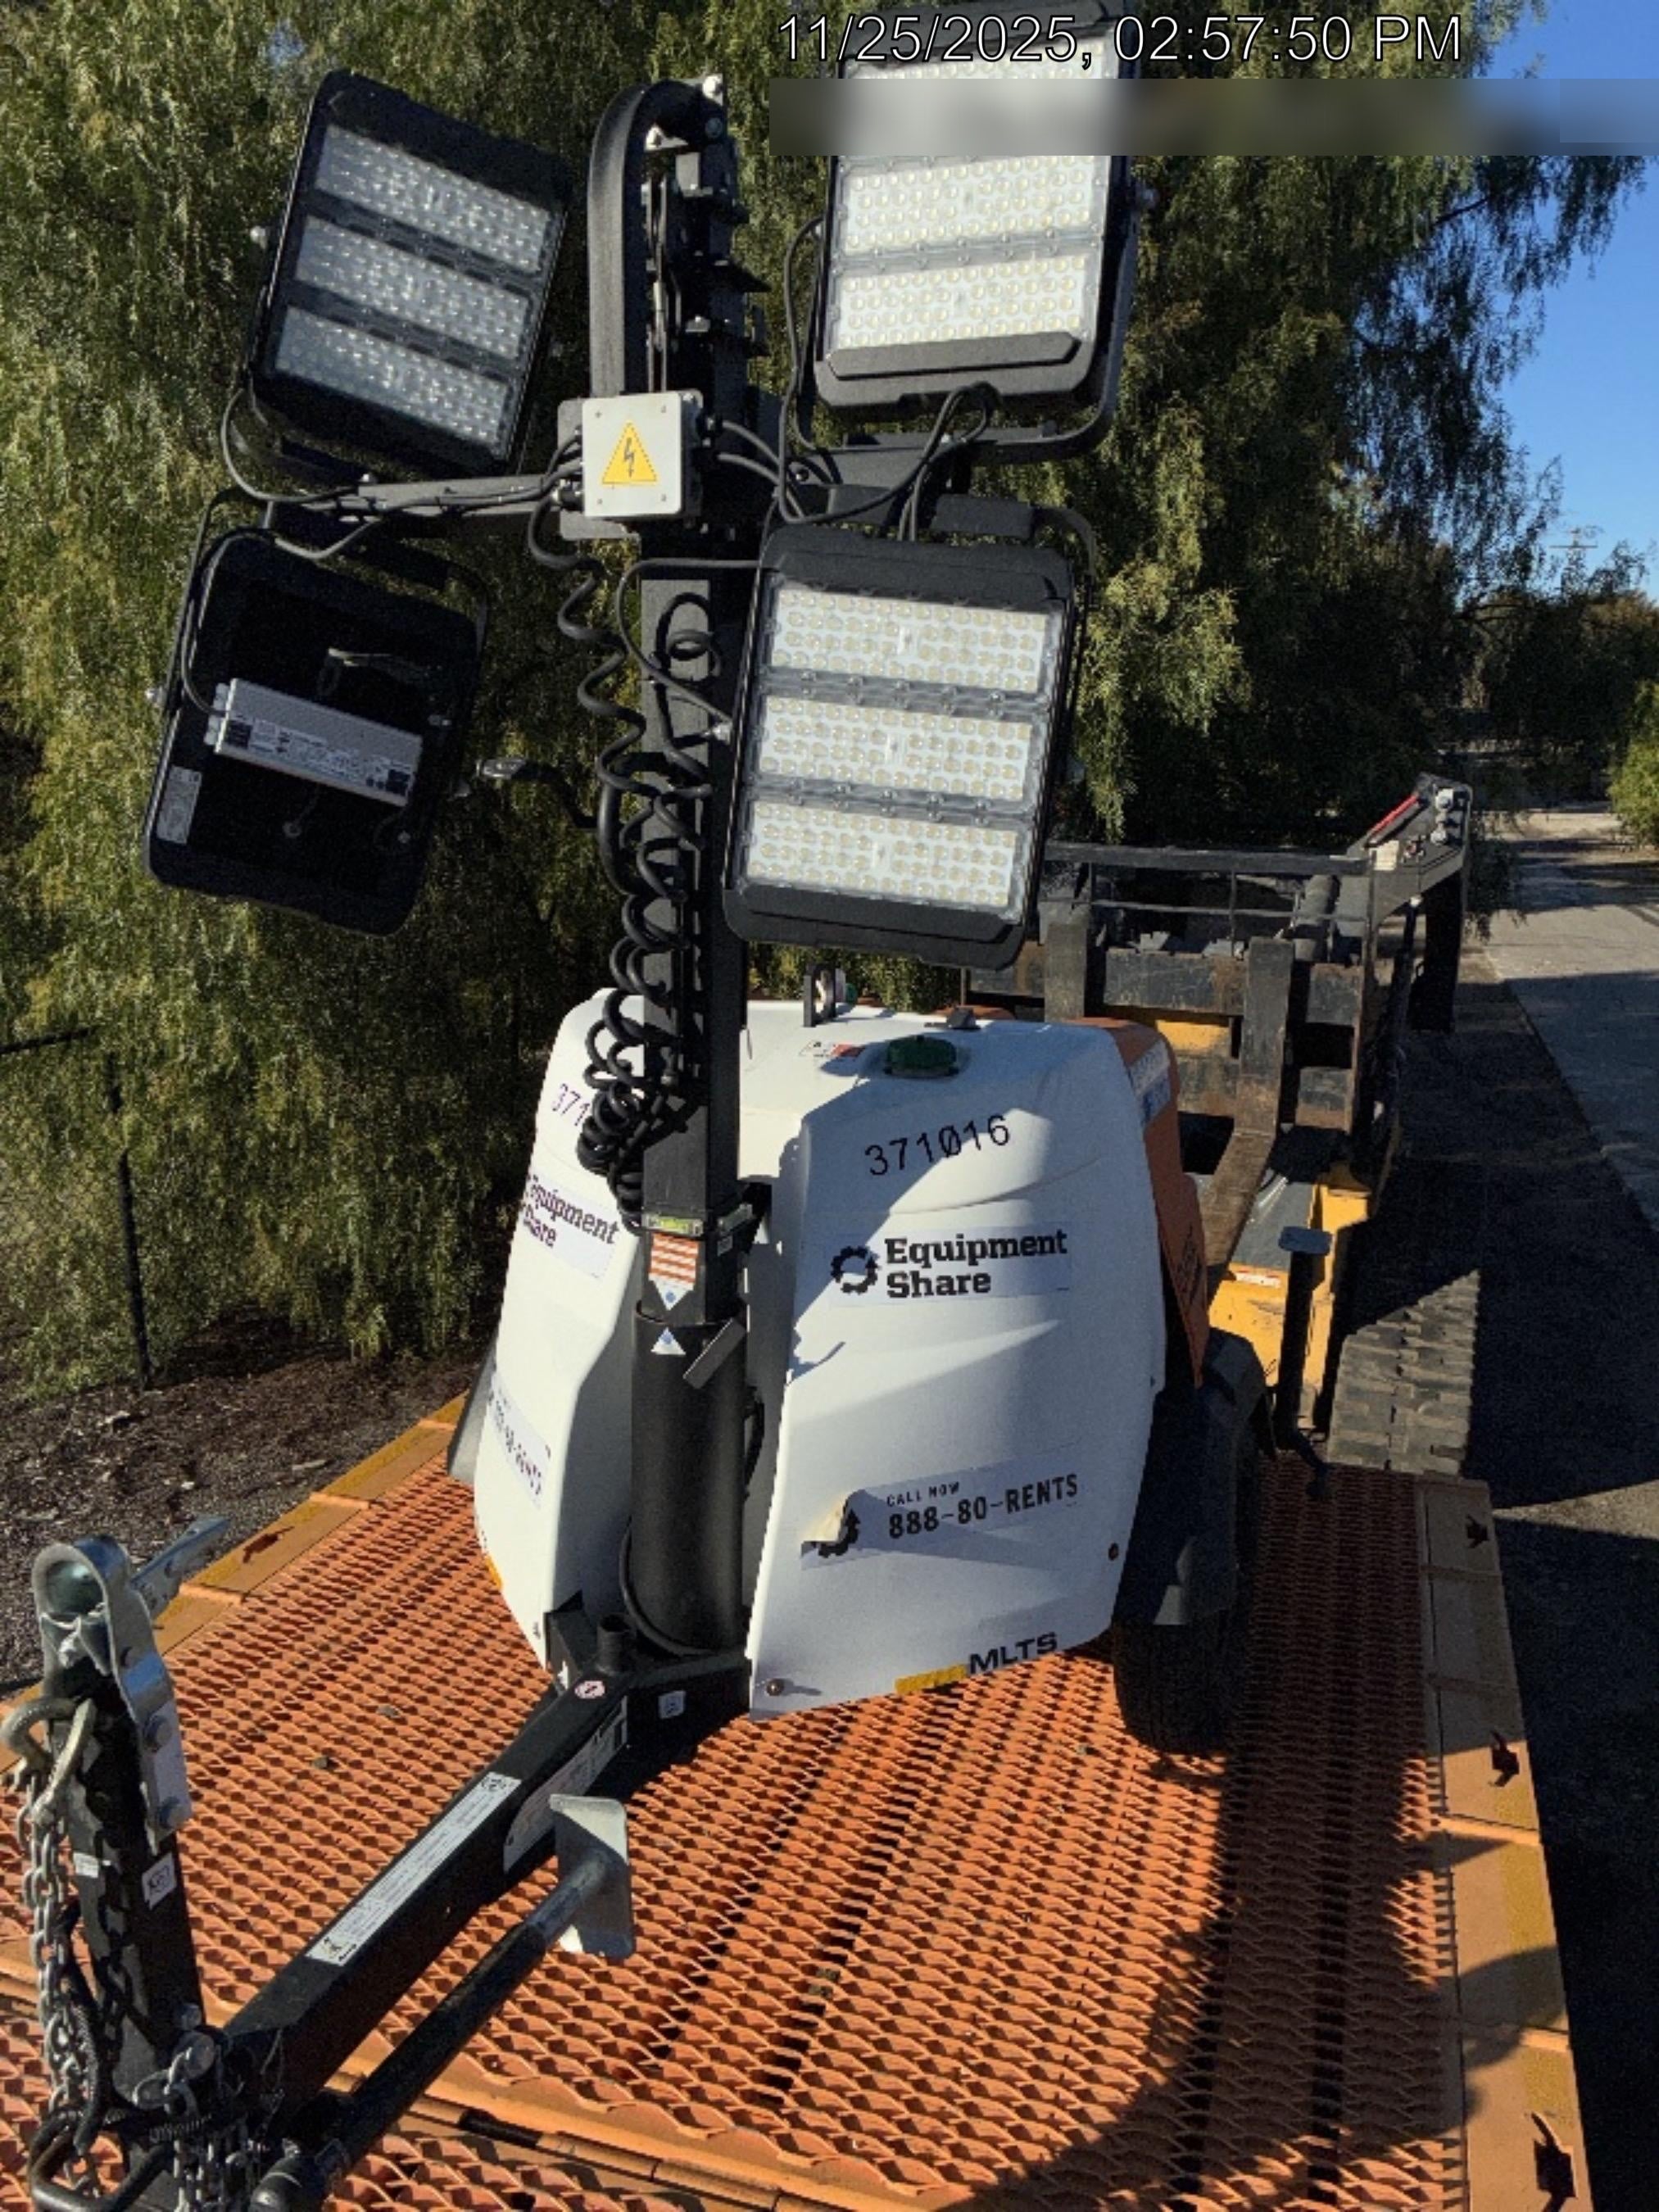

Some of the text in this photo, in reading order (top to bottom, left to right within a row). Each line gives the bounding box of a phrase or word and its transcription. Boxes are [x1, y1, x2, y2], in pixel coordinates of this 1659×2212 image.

[865, 1114, 1009, 1175] 371016
[885, 1230, 1067, 1268] Equipment
[886, 1271, 991, 1299] Share
[886, 1481, 960, 1507] CALL NOW
[889, 1474, 1077, 1539] 888-80-RENTS
[970, 1632, 1058, 1675] MLTS
